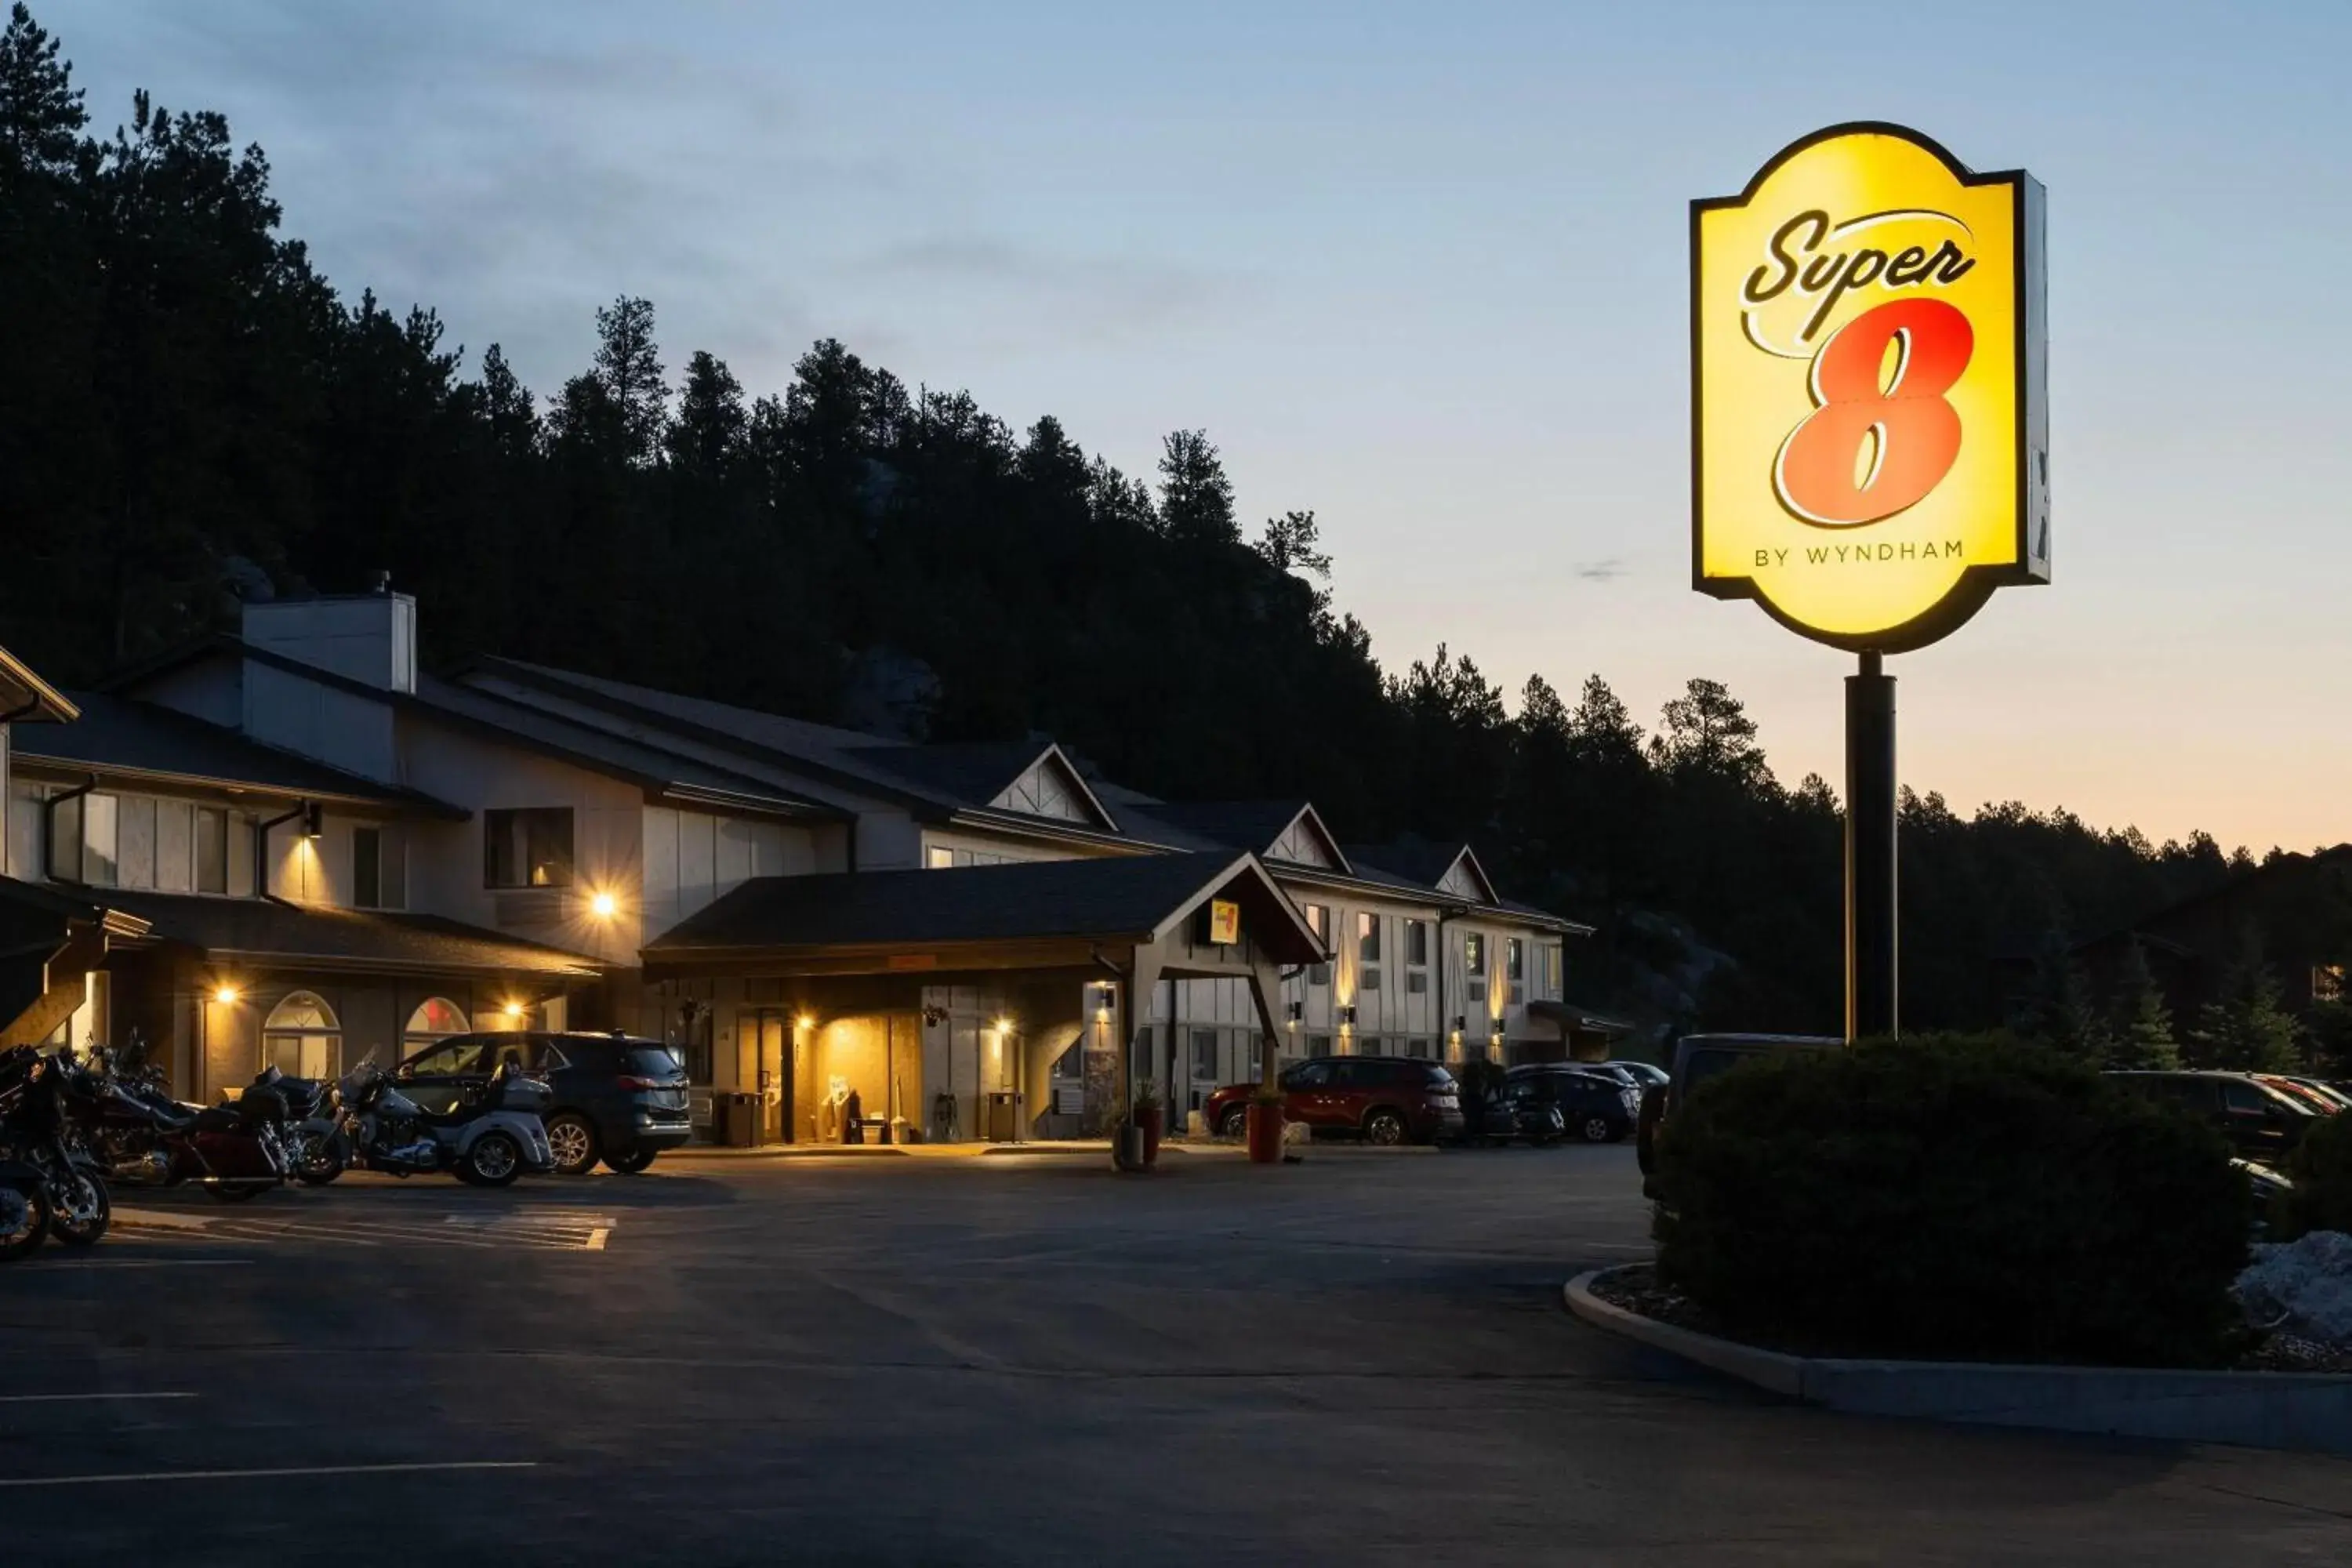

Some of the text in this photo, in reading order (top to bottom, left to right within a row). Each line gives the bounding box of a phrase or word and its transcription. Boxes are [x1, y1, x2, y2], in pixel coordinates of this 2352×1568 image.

[1742, 209, 1975, 342] Super
[1770, 298, 1974, 530] 8
[1755, 540, 1963, 567] BY WYNDHAM
